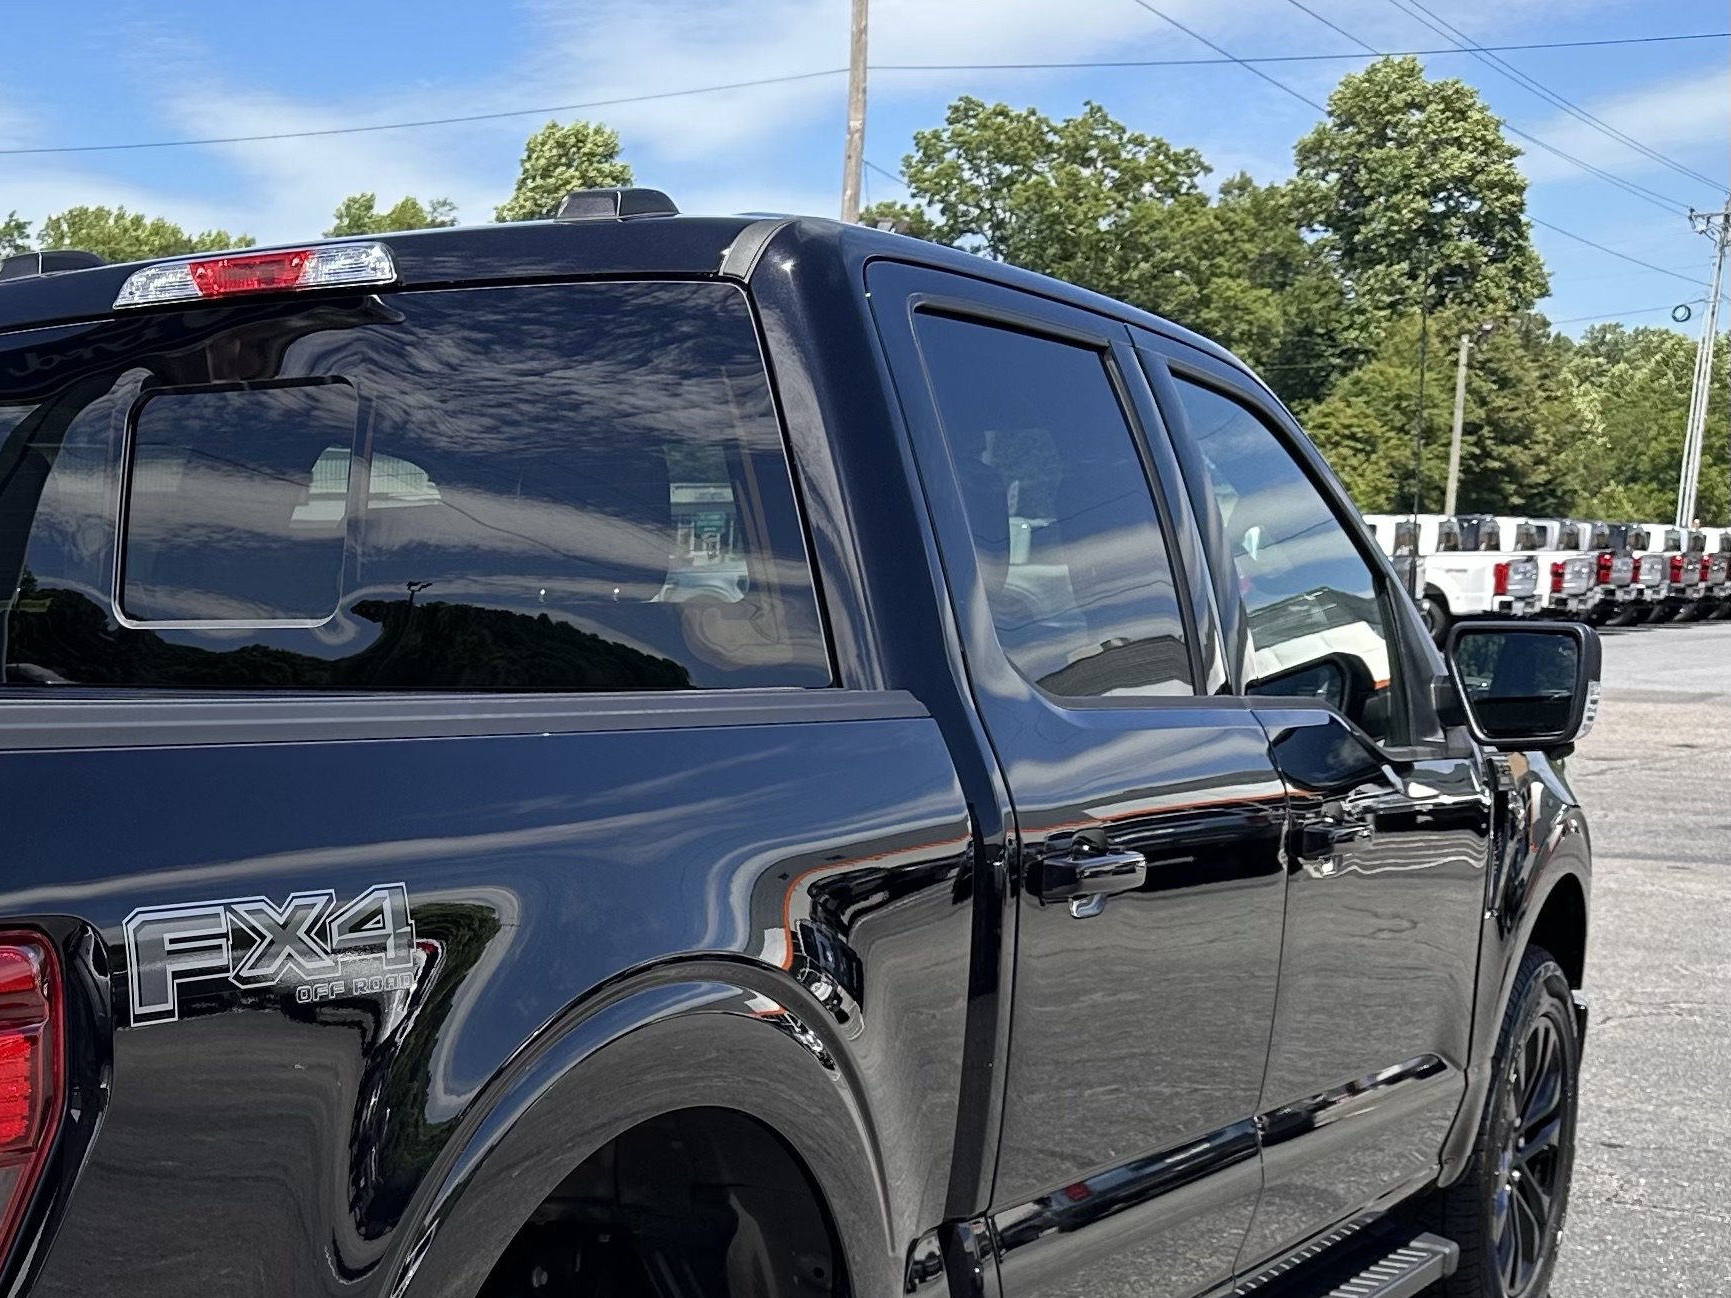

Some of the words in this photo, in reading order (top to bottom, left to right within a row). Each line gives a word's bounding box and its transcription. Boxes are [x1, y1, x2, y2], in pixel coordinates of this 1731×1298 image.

[122, 882, 416, 1027] FX4
[296, 979, 346, 1004] OFF
[353, 971, 416, 996] ROAD
